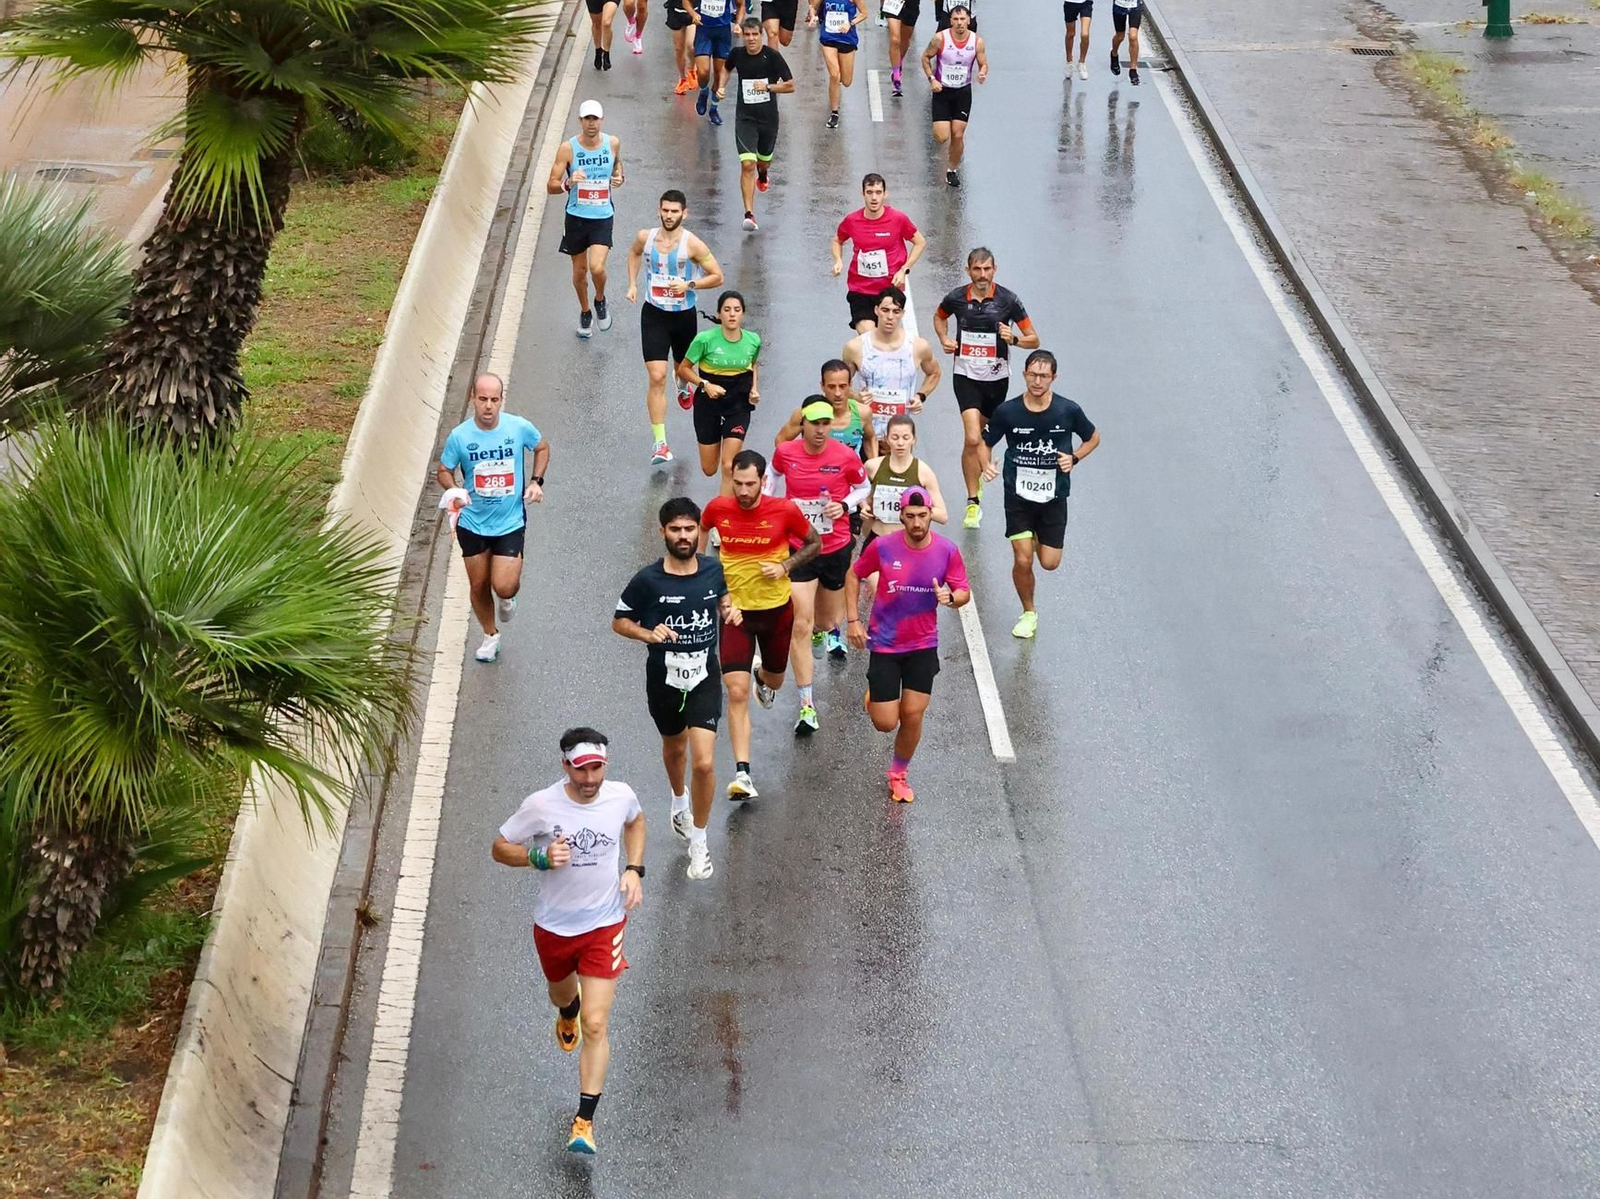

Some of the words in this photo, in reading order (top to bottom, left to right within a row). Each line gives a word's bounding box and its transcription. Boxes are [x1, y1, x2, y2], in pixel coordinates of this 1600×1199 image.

[703, 3, 724, 12] 11938
[578, 155, 609, 166] nerja
[588, 191, 600, 200] 58
[861, 261, 882, 270] 1451
[968, 346, 988, 357] 265
[876, 405, 897, 415] 343
[469, 446, 514, 462] nerja
[484, 476, 506, 487] 268
[1020, 480, 1053, 492] 10240
